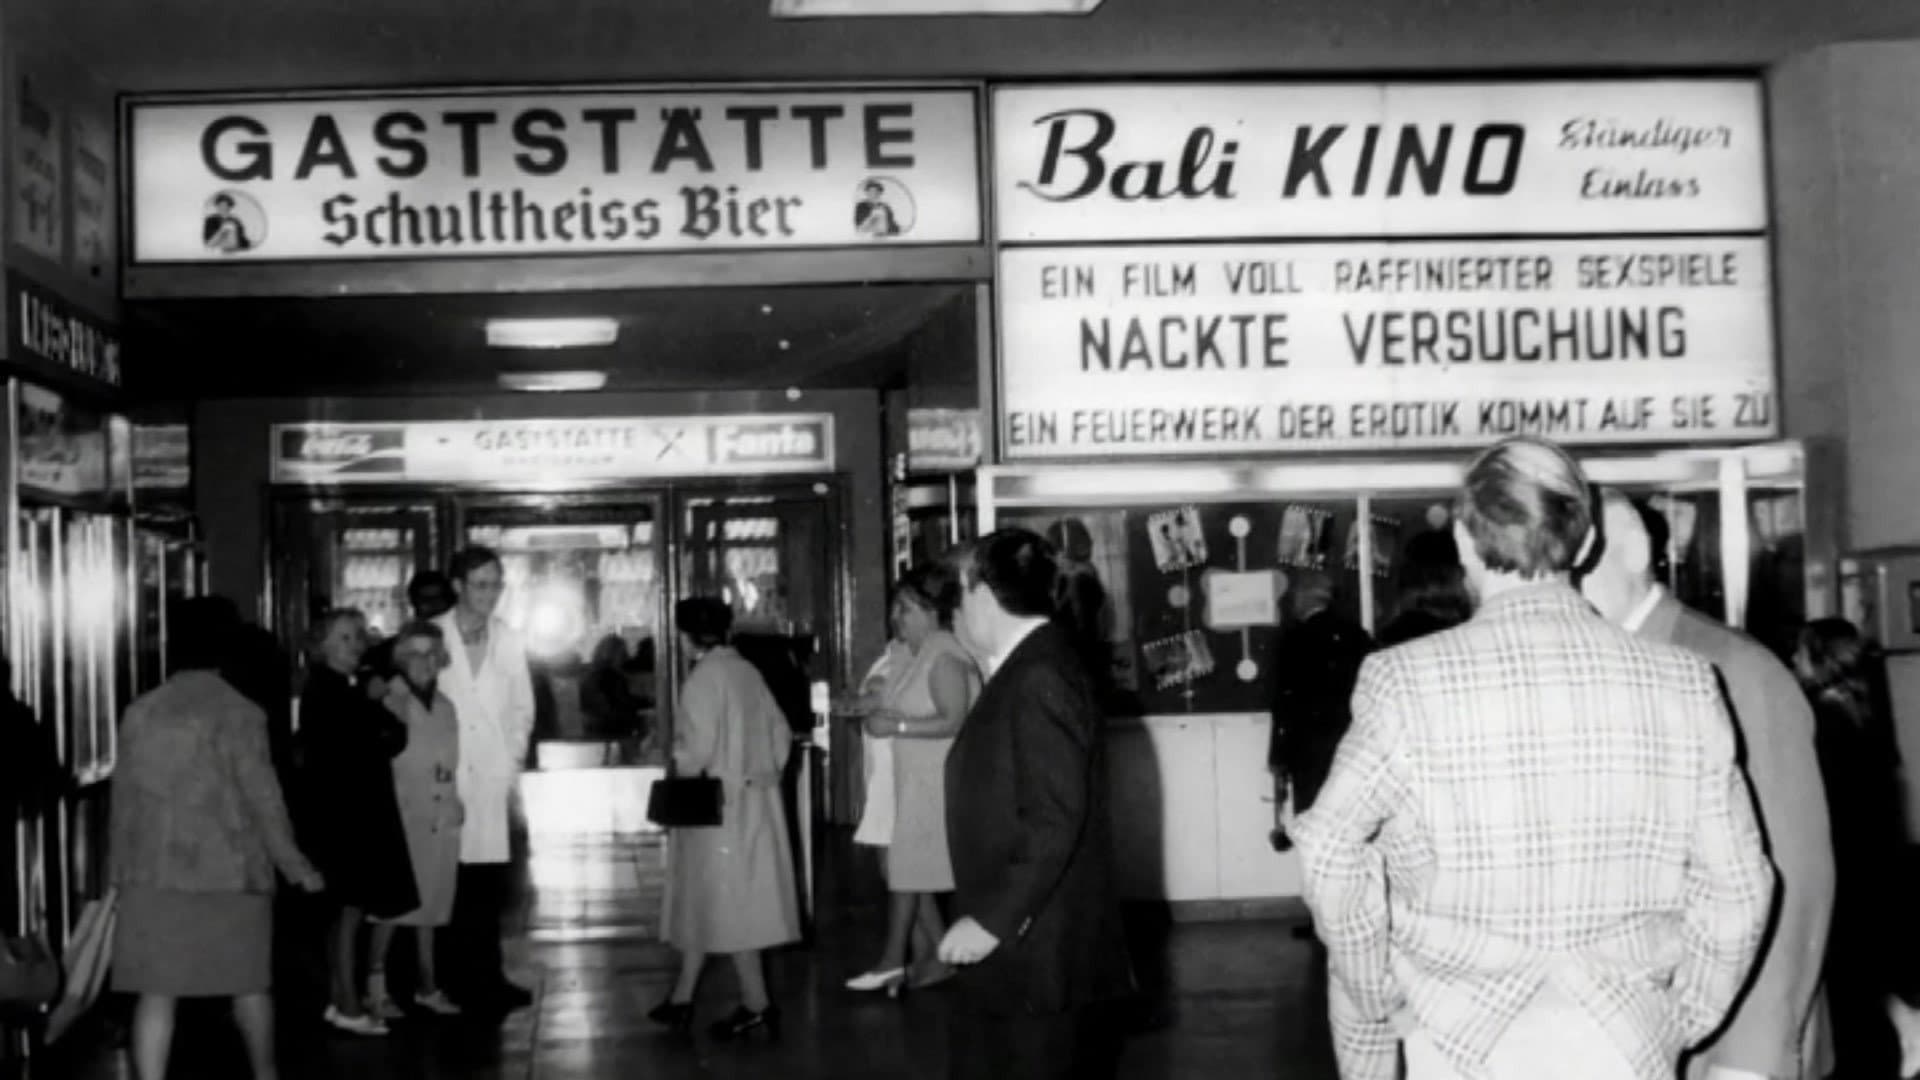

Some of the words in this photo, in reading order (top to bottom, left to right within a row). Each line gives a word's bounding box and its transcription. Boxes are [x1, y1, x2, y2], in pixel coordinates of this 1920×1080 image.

[201, 104, 915, 181] GASTSTÄTTE
[1016, 108, 1239, 201] Bali
[1281, 122, 1526, 199] KINO
[1580, 168, 1701, 199] Einlass
[322, 187, 661, 246] Schultheiss
[679, 184, 802, 238] Bier
[1041, 265, 1095, 298] EIN
[1122, 262, 1197, 297] FILM
[1222, 261, 1302, 295] VOLL
[1334, 256, 1553, 294] RAFFINIERTER
[1577, 252, 1738, 289] SEXSPIELE
[1079, 313, 1290, 372] NACKTE
[1343, 306, 1686, 365] VERSUCHUNG
[714, 425, 815, 463] Fanta
[1008, 411, 1058, 446] EIN
[1071, 406, 1262, 444] FEUERWERK
[1278, 403, 1335, 440] DER
[1350, 400, 1460, 437] EROTIK
[1477, 397, 1588, 435] KOMMT
[1599, 396, 1654, 432] AUF
[1670, 394, 1718, 430] SIE
[1733, 393, 1770, 429] ZU
